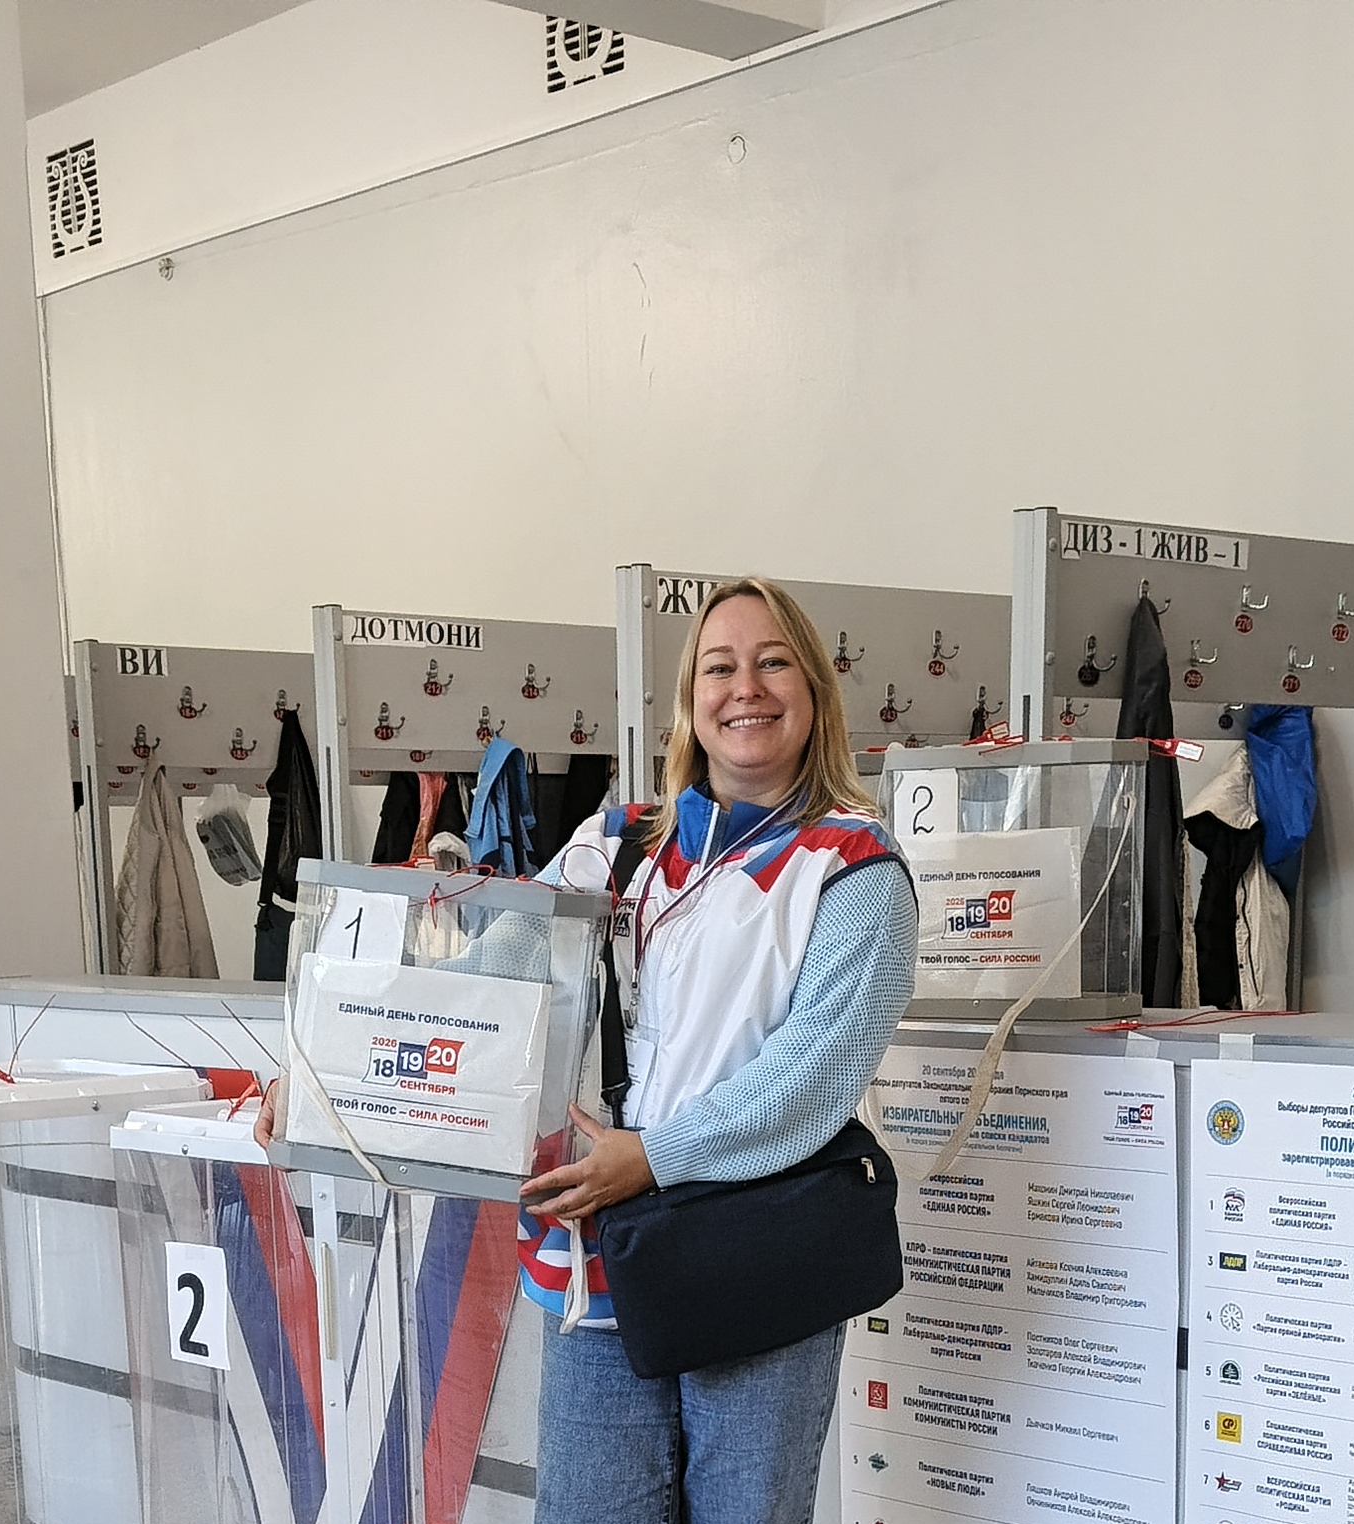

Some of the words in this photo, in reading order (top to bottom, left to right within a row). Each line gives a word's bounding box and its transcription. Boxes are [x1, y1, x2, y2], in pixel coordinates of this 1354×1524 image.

[1063, 522, 1113, 554] ДИЗ
[1134, 531, 1144, 556] 1
[1152, 531, 1209, 563] ЖИВ
[1232, 542, 1242, 568] 1
[351, 616, 482, 648] ДОТМОНИ
[119, 648, 165, 676] ВИ
[426, 684, 441, 694] 212
[912, 785, 935, 835] 2
[920, 871, 954, 882] ЕДИНЫЙ
[955, 872, 977, 881] ДЕНЬ
[978, 869, 1041, 880] ГОЛОСОВАНИЯ
[947, 916, 965, 932] 18
[968, 905, 985, 923] 19
[989, 896, 1010, 914] 20
[345, 906, 363, 959] 1
[970, 930, 1013, 939] СЕНТЯБРЯ
[920, 954, 942, 964] ТВОЙ
[943, 955, 970, 964] ГОЛОС
[979, 954, 1002, 963] СИЛА
[1003, 954, 1041, 963] РОССИИ!
[338, 1002, 385, 1018] ЕДИНЫЙ
[386, 1009, 416, 1024] ДЕНЬ
[418, 1013, 500, 1033] ГОЛОСОВАНИЯ
[372, 1036, 397, 1048] 2026
[372, 1058, 395, 1078] 18
[401, 1052, 424, 1072] 19
[428, 1046, 456, 1067] 20
[399, 1079, 456, 1095] СЕНТЯБРЯ
[330, 1097, 359, 1110] ТВОЙ
[361, 1102, 397, 1115] ГОЛОС
[408, 1108, 438, 1122] СИЛА
[440, 1113, 489, 1128] РОССИИ!
[1141, 1107, 1152, 1117] 20
[1277, 1101, 1309, 1114] Выборы
[1309, 1103, 1348, 1116] депутатов
[176, 1272, 209, 1357] 2
